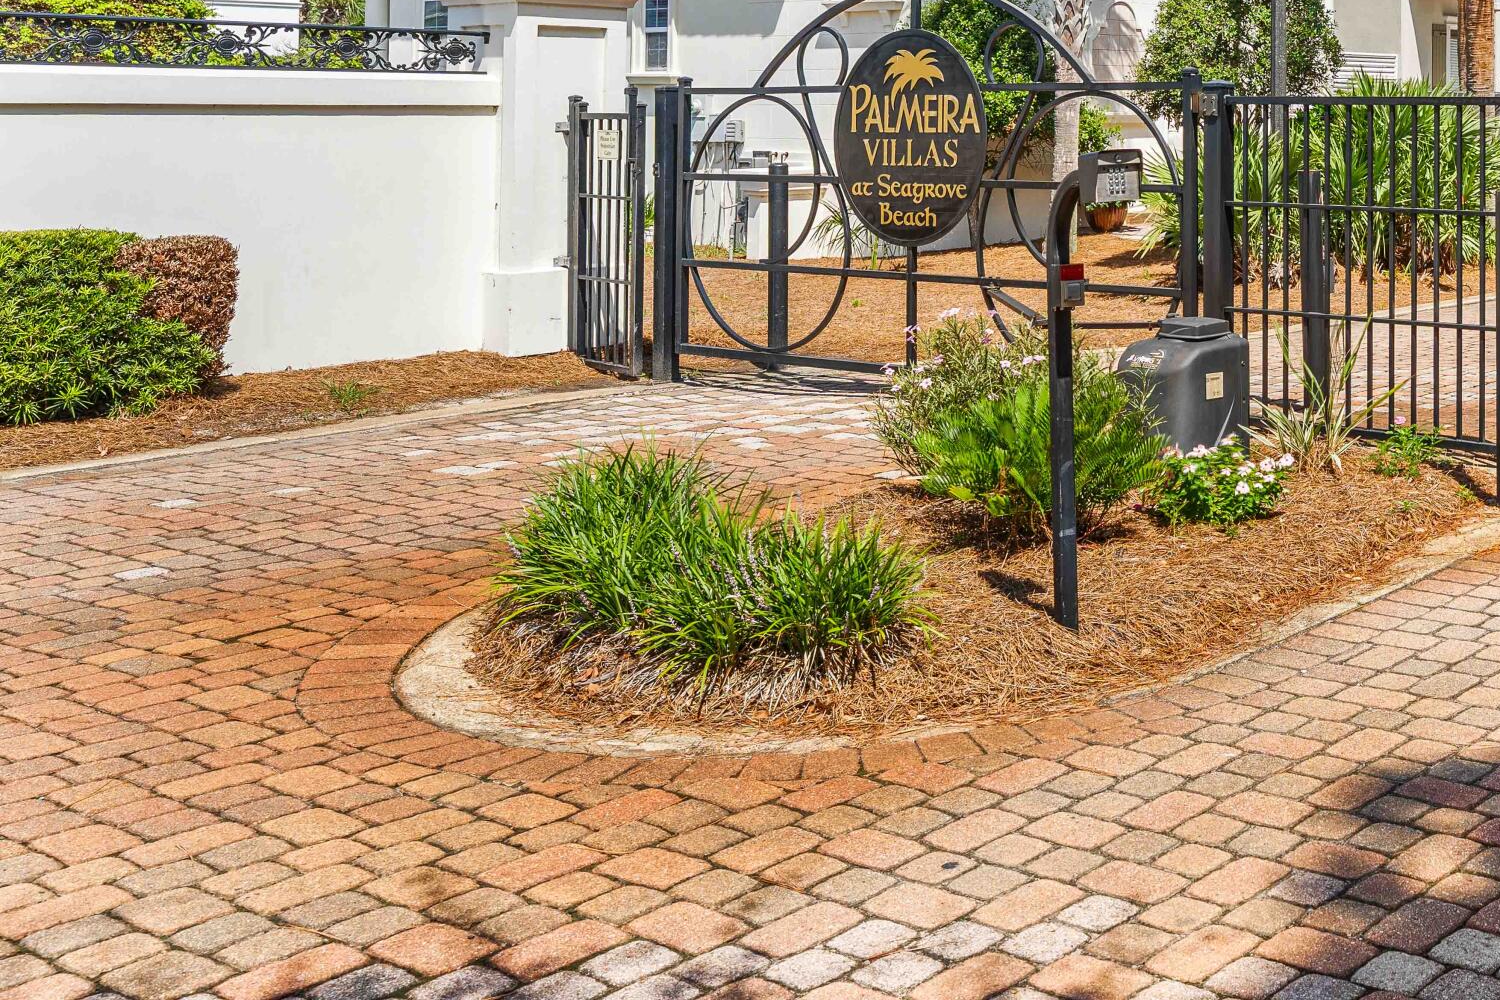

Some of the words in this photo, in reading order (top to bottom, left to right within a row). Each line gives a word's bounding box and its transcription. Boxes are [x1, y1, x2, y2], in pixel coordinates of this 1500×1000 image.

[849, 84, 980, 134] PALMEIRA
[863, 138, 958, 168] VILLAS
[851, 180, 873, 196] at
[878, 174, 967, 202] Seagrove
[879, 202, 937, 227] Beach
